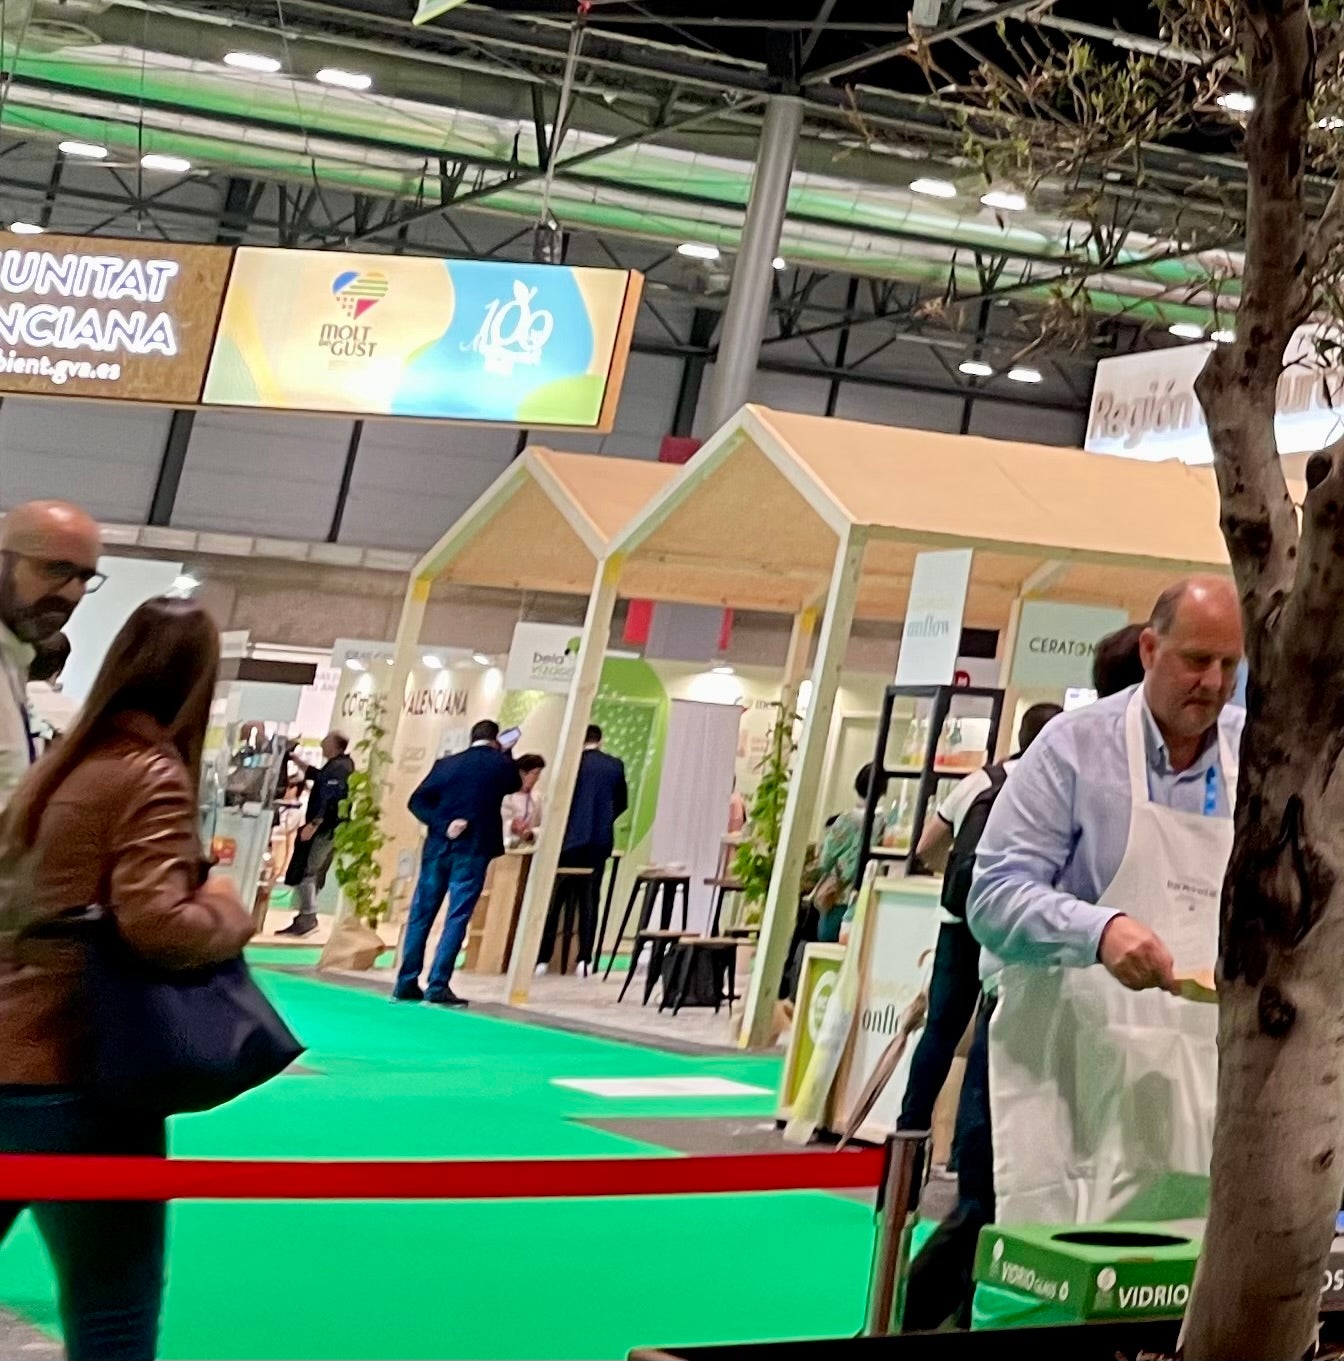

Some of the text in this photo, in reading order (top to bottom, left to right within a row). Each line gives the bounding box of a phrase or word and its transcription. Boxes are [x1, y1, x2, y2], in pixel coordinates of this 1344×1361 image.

[0, 250, 179, 302] UNITAT
[320, 324, 373, 340] MOLT
[331, 340, 378, 357] GUST
[1090, 379, 1194, 449] Región
[1002, 1260, 1035, 1291] VIDRIO
[1118, 1284, 1189, 1309] VIDRIO
